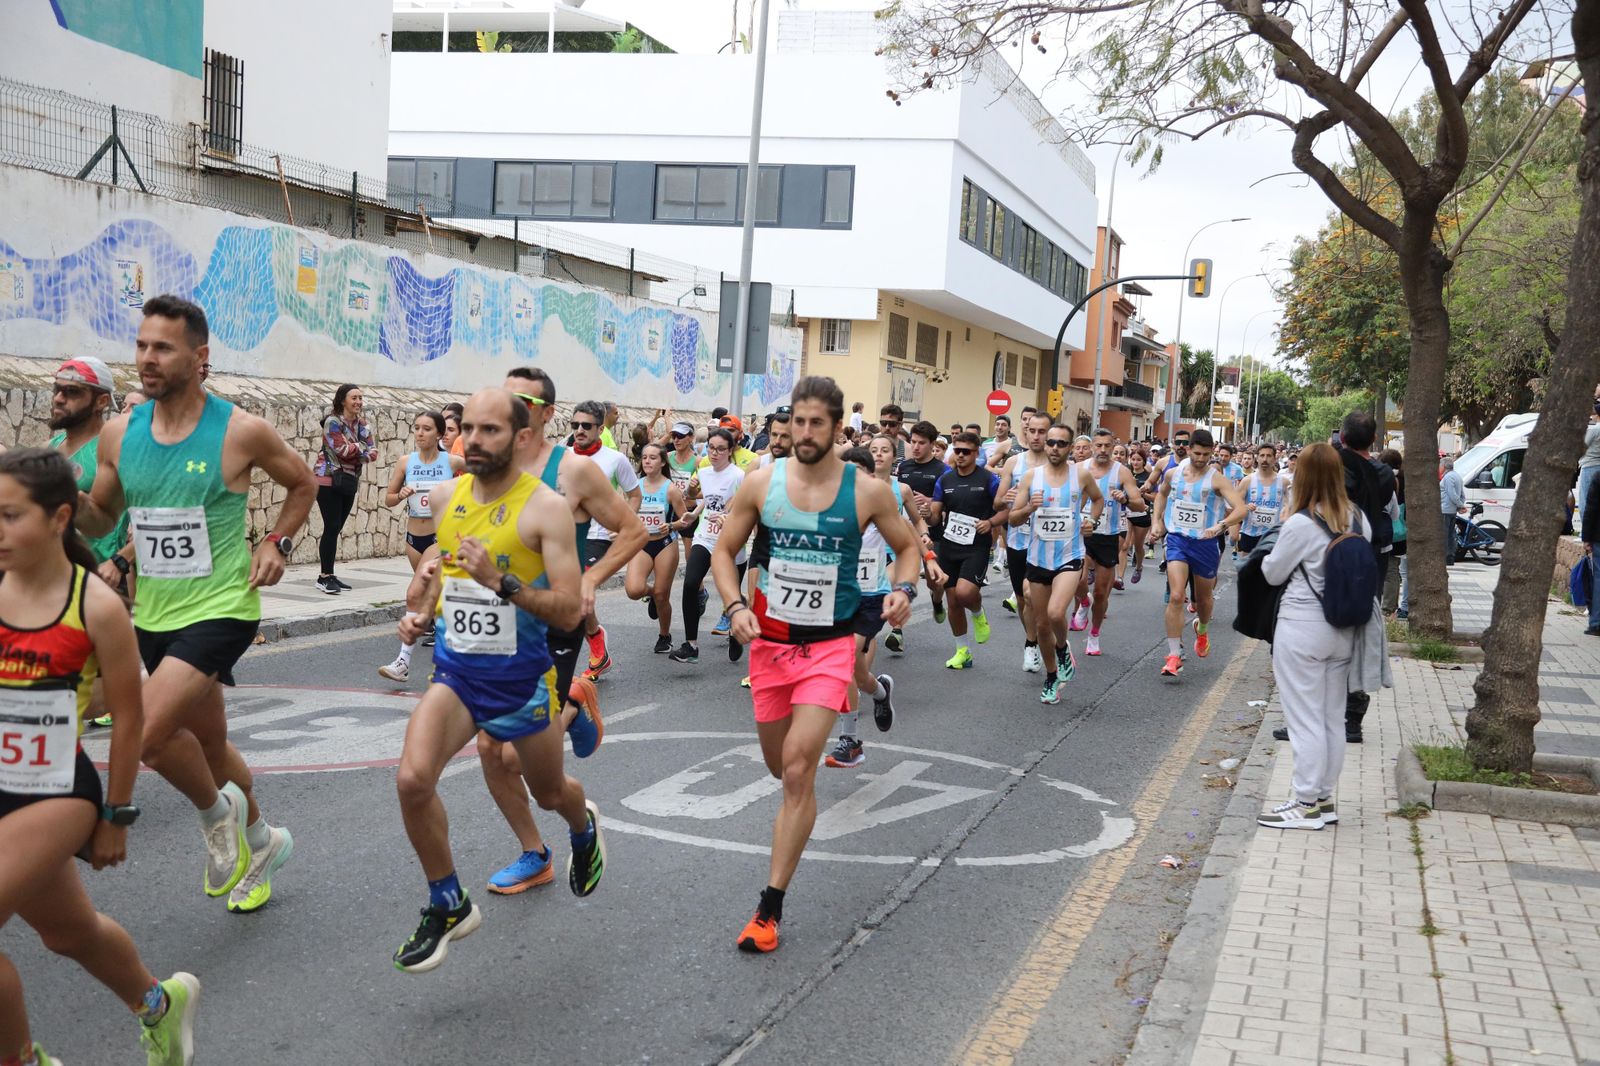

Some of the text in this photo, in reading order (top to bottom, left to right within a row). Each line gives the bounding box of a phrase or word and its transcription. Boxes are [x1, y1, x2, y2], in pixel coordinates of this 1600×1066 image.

[412, 467, 443, 477] nerja
[1178, 511, 1198, 523] 525
[1256, 514, 1272, 523] 509
[950, 524, 970, 538] 452
[1042, 521, 1066, 532] 422
[146, 536, 195, 560] 763
[772, 531, 844, 551] WATT
[781, 586, 823, 610] 778
[454, 609, 501, 636] 863
[0, 732, 52, 767] 51
